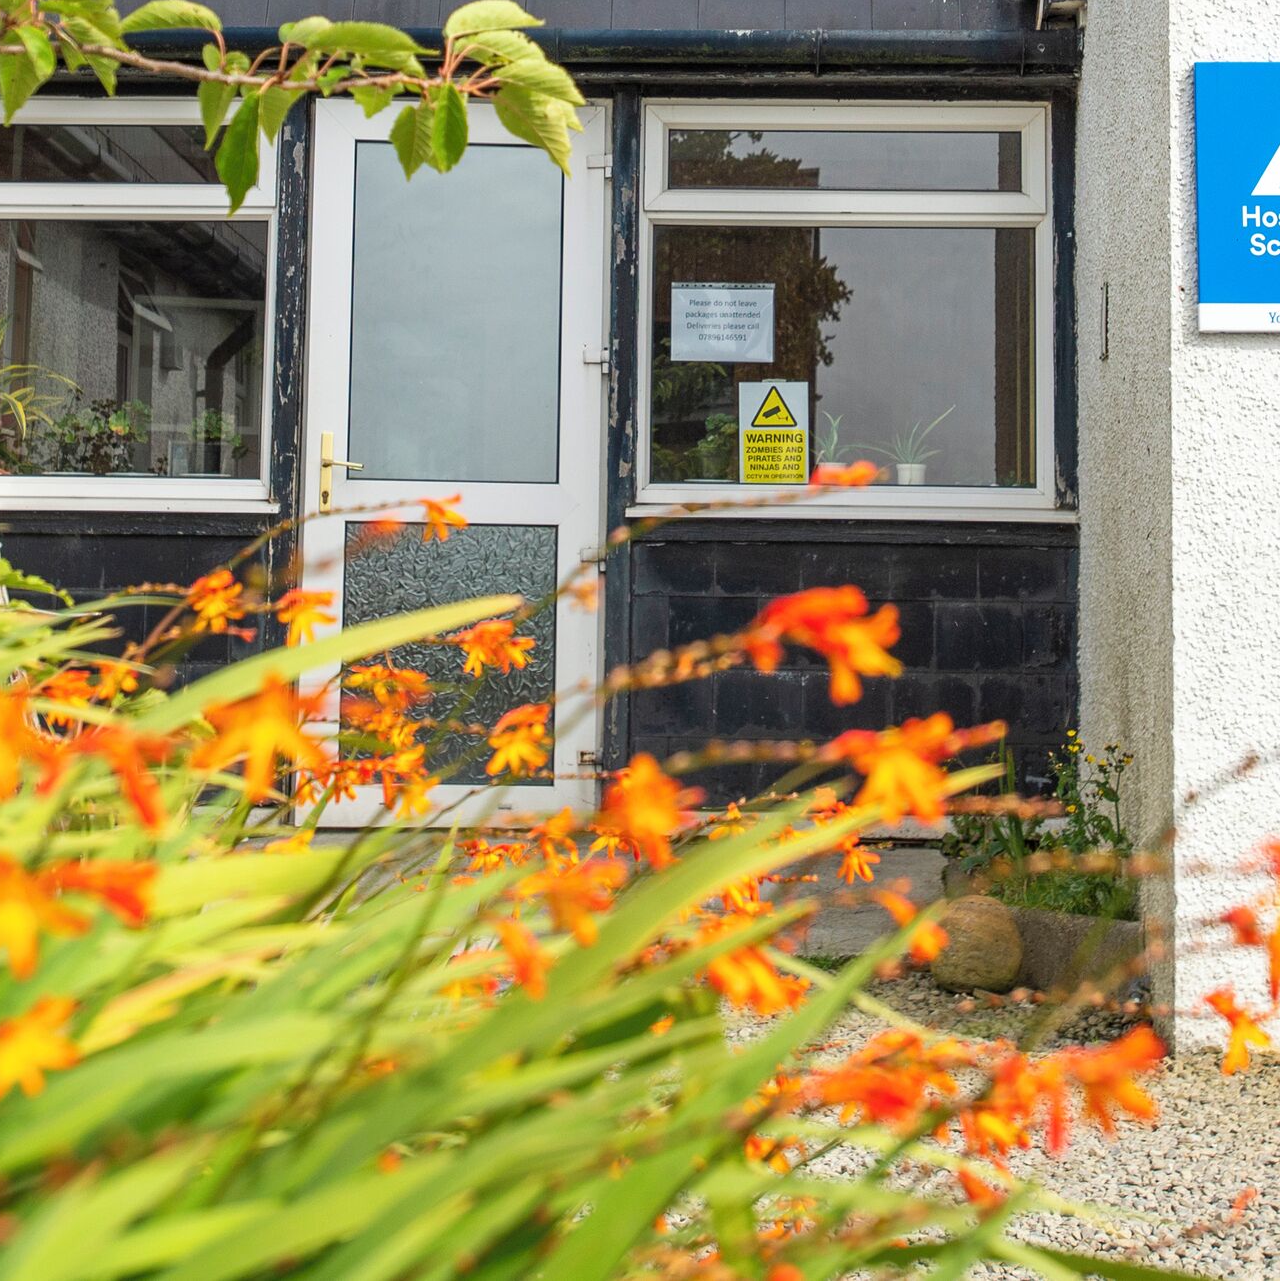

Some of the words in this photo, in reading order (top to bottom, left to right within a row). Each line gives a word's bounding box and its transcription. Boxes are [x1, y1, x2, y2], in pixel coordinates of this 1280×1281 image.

[738, 299, 757, 307] leave
[686, 322, 721, 330] Deliveries
[746, 433, 803, 443] WARNING
[746, 446, 783, 454] ZOMBIES
[786, 446, 803, 454] AND
